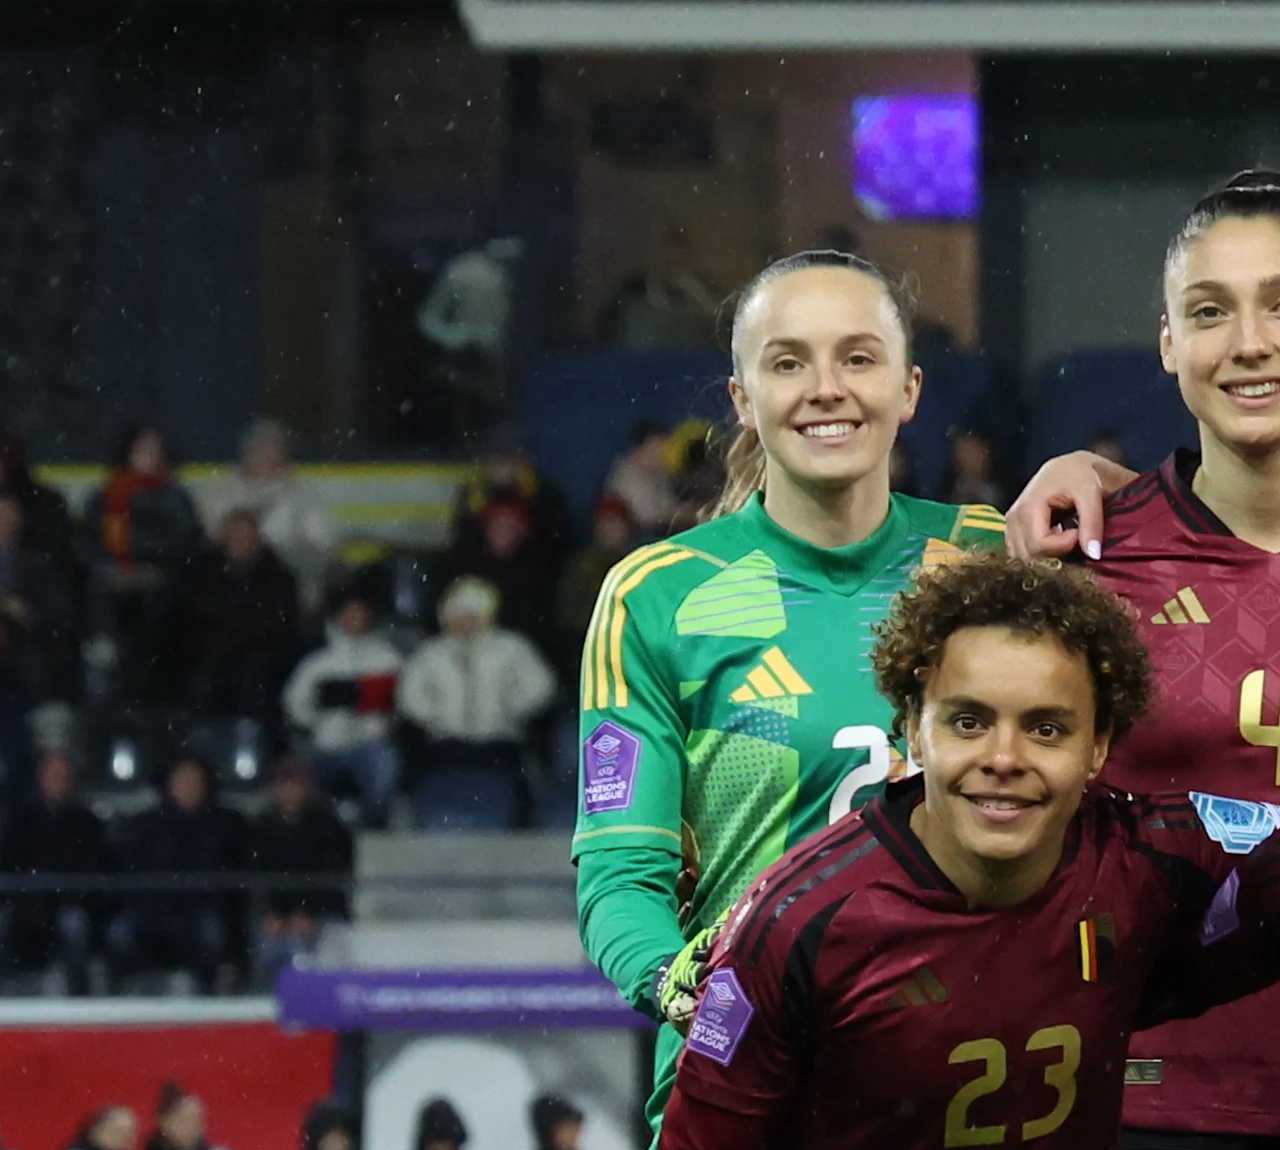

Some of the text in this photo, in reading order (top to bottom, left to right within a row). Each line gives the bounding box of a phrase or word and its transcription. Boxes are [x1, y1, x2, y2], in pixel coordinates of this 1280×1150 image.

[584, 781, 627, 795] NATIONS
[586, 790, 624, 803] LEAGUE
[943, 1024, 1081, 1148] 23
